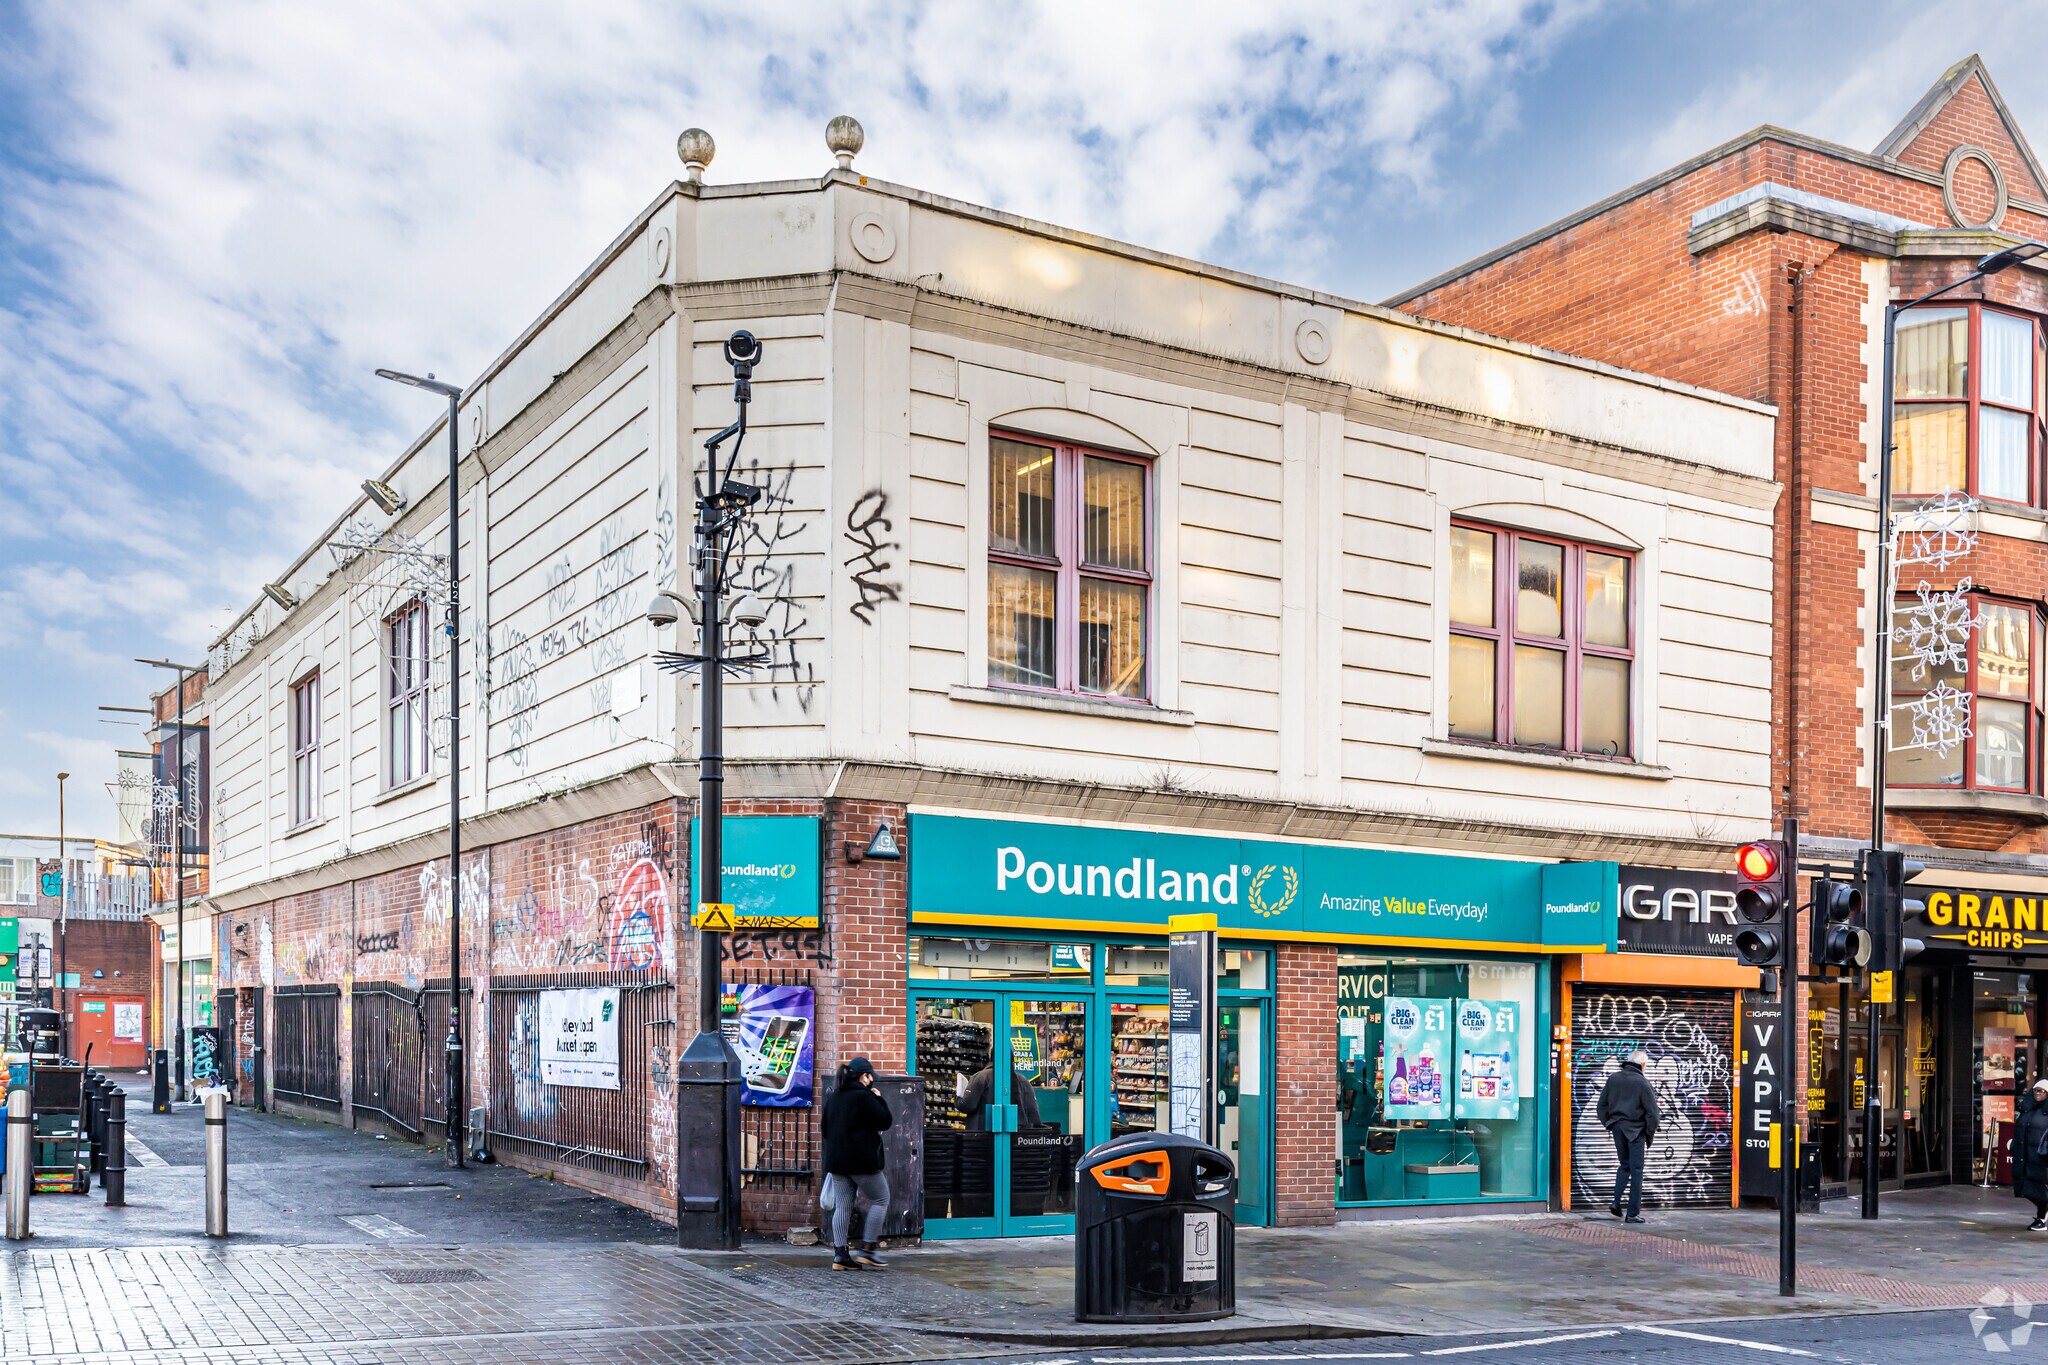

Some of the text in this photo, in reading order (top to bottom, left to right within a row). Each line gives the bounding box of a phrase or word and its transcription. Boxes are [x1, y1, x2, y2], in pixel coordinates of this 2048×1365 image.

[876, 845, 896, 853] Chubb
[720, 864, 778, 877] oundland
[996, 846, 1239, 905] Poundland
[1319, 893, 1488, 922] Amazing Value Everyday!
[1545, 902, 1590, 914] Poundland
[1617, 883, 1738, 925] IGAR
[1707, 932, 1733, 945] VAPE
[1966, 929, 2024, 949] CHIPS
[1395, 1009, 1410, 1018] BIG
[1466, 1010, 1481, 1019] BIG
[1807, 1009, 1826, 1021] GRAND
[1391, 1017, 1415, 1026] CLEAN
[1424, 1010, 1445, 1031] £1
[1462, 1018, 1485, 1027] CLEAN
[1495, 1012, 1514, 1033] £1
[1752, 1024, 1776, 1132] VAPE
[1807, 1088, 1826, 1097] GERMAN
[1807, 1097, 1826, 1111] DÖNER
[1017, 1136, 1061, 1146] Poundland
